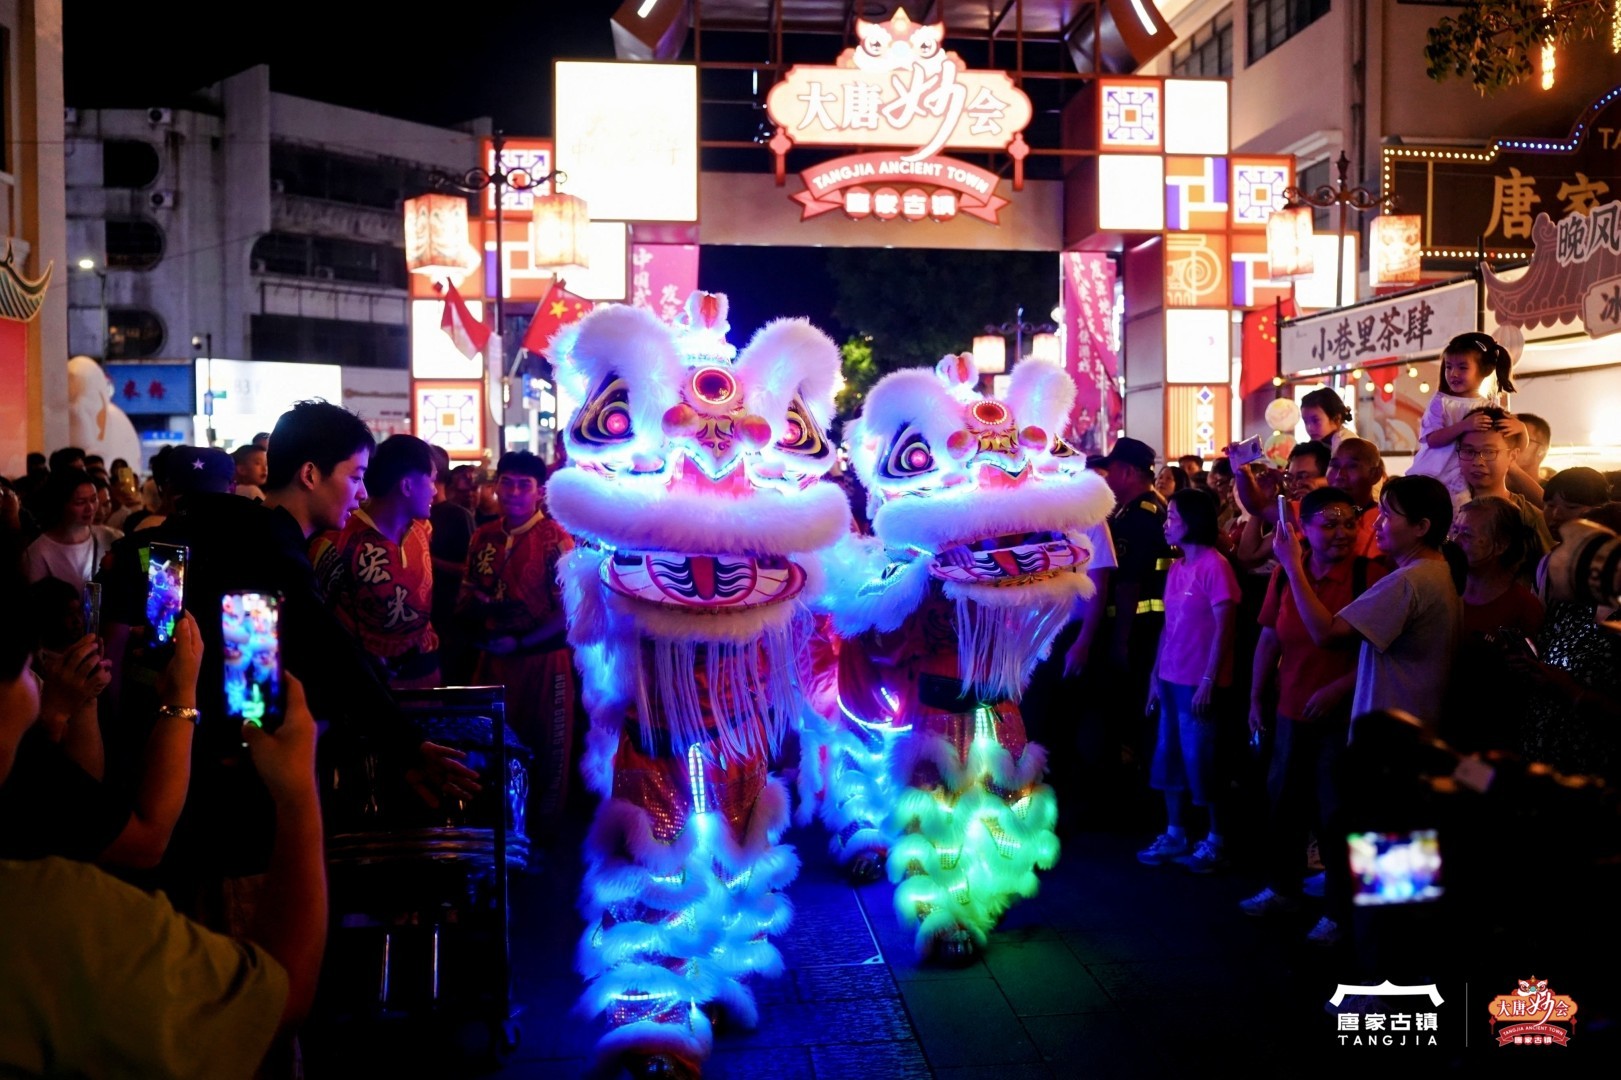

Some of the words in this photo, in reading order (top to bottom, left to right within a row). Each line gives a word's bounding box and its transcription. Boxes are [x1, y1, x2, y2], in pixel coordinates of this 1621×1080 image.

[797, 60, 1011, 162] 大唐妙会
[812, 161, 875, 189] TANGJIA
[879, 161, 943, 177] ANCIENT
[947, 166, 989, 194] TOWN
[1559, 205, 1620, 261] 晚风
[1312, 300, 1435, 361] 小巷里茶肆
